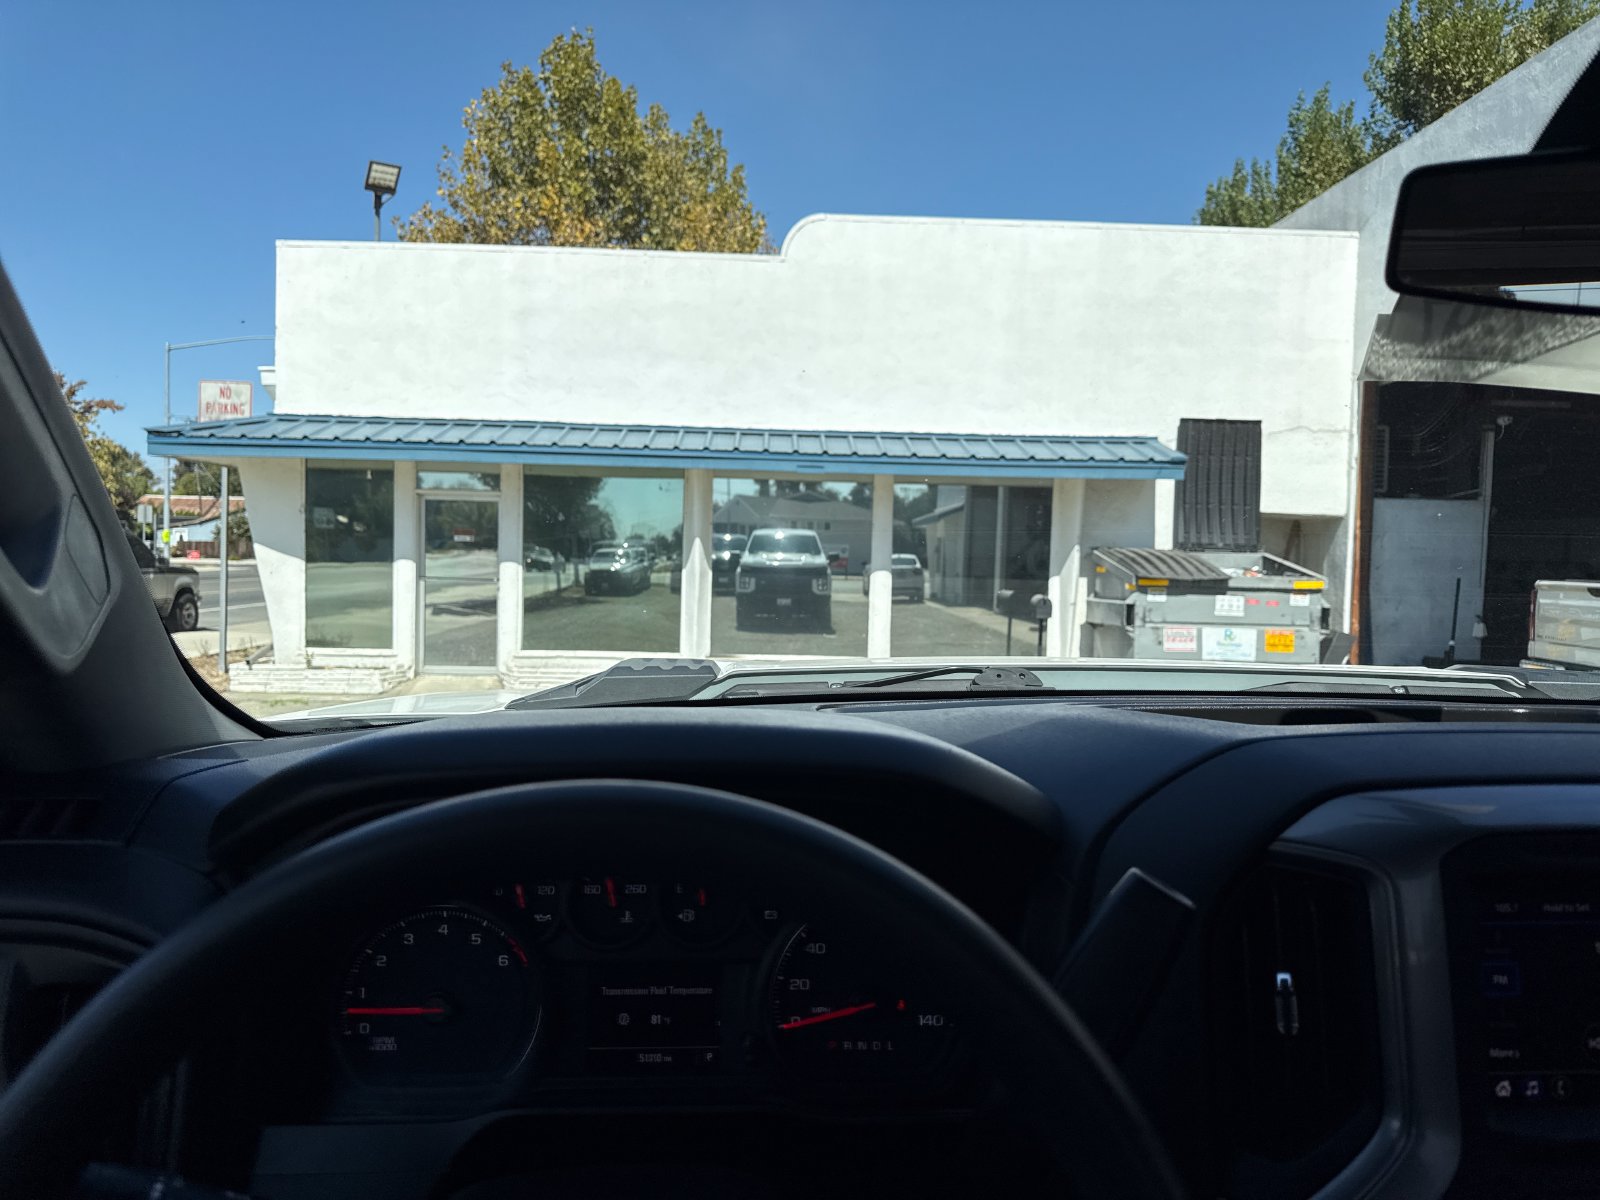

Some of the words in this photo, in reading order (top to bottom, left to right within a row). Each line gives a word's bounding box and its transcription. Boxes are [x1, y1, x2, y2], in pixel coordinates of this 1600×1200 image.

[219, 385, 232, 400] NO
[205, 401, 246, 416] PARKING
[624, 884, 647, 894] 260
[437, 924, 449, 936] 4
[403, 933, 415, 945] 3
[470, 933, 482, 945] 5
[805, 942, 827, 955] 40
[375, 954, 388, 967] 2
[497, 955, 509, 967] 6
[789, 978, 811, 991] 20
[359, 987, 366, 999] 1
[651, 1013, 662, 1025] 81
[919, 1013, 945, 1027] 140
[359, 1022, 371, 1034] 0
